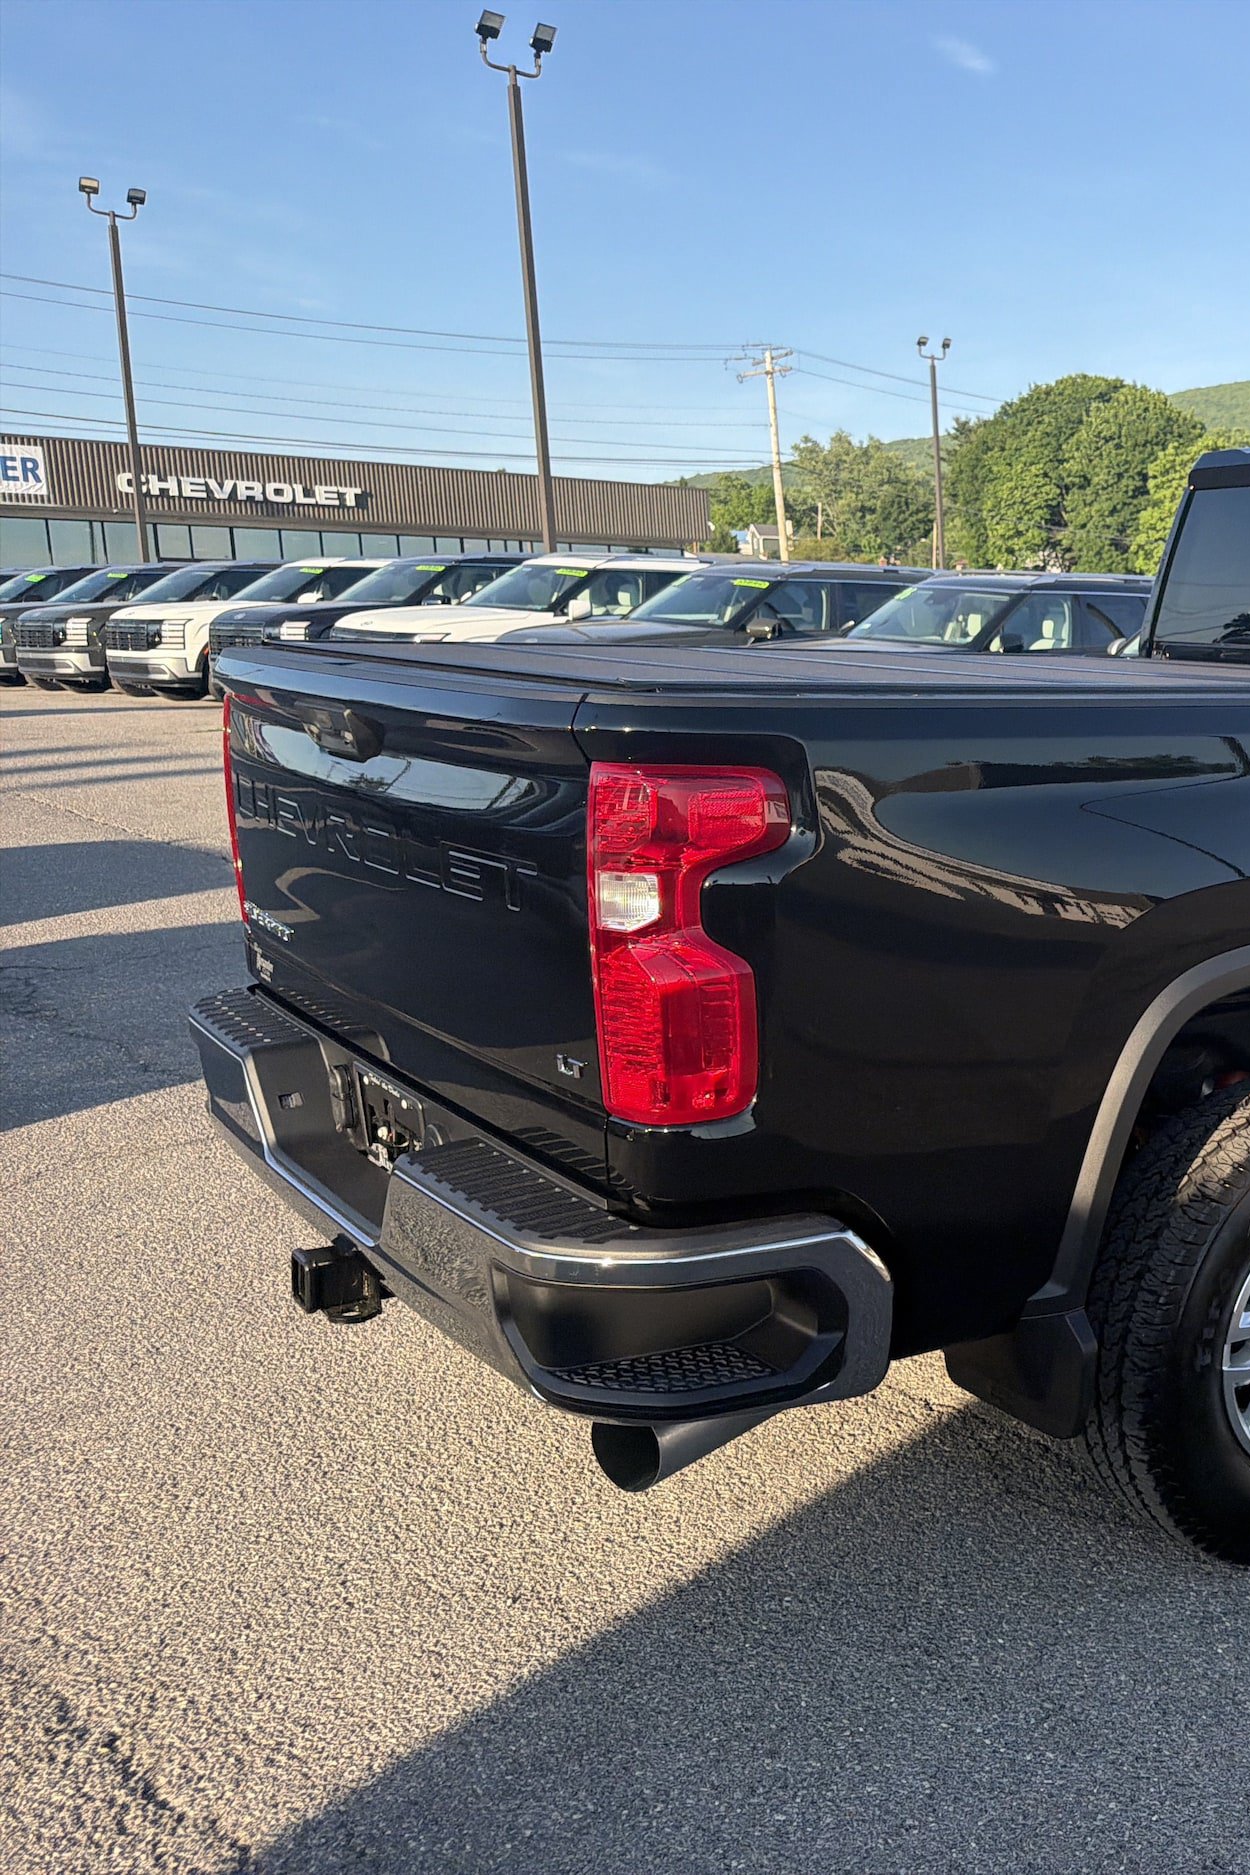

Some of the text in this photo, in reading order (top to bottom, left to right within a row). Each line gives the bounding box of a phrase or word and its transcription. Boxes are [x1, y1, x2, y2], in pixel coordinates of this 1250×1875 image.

[117, 472, 362, 507] CHEVROLET
[236, 771, 538, 911] CHEVROLET
[556, 1054, 588, 1079] LT
